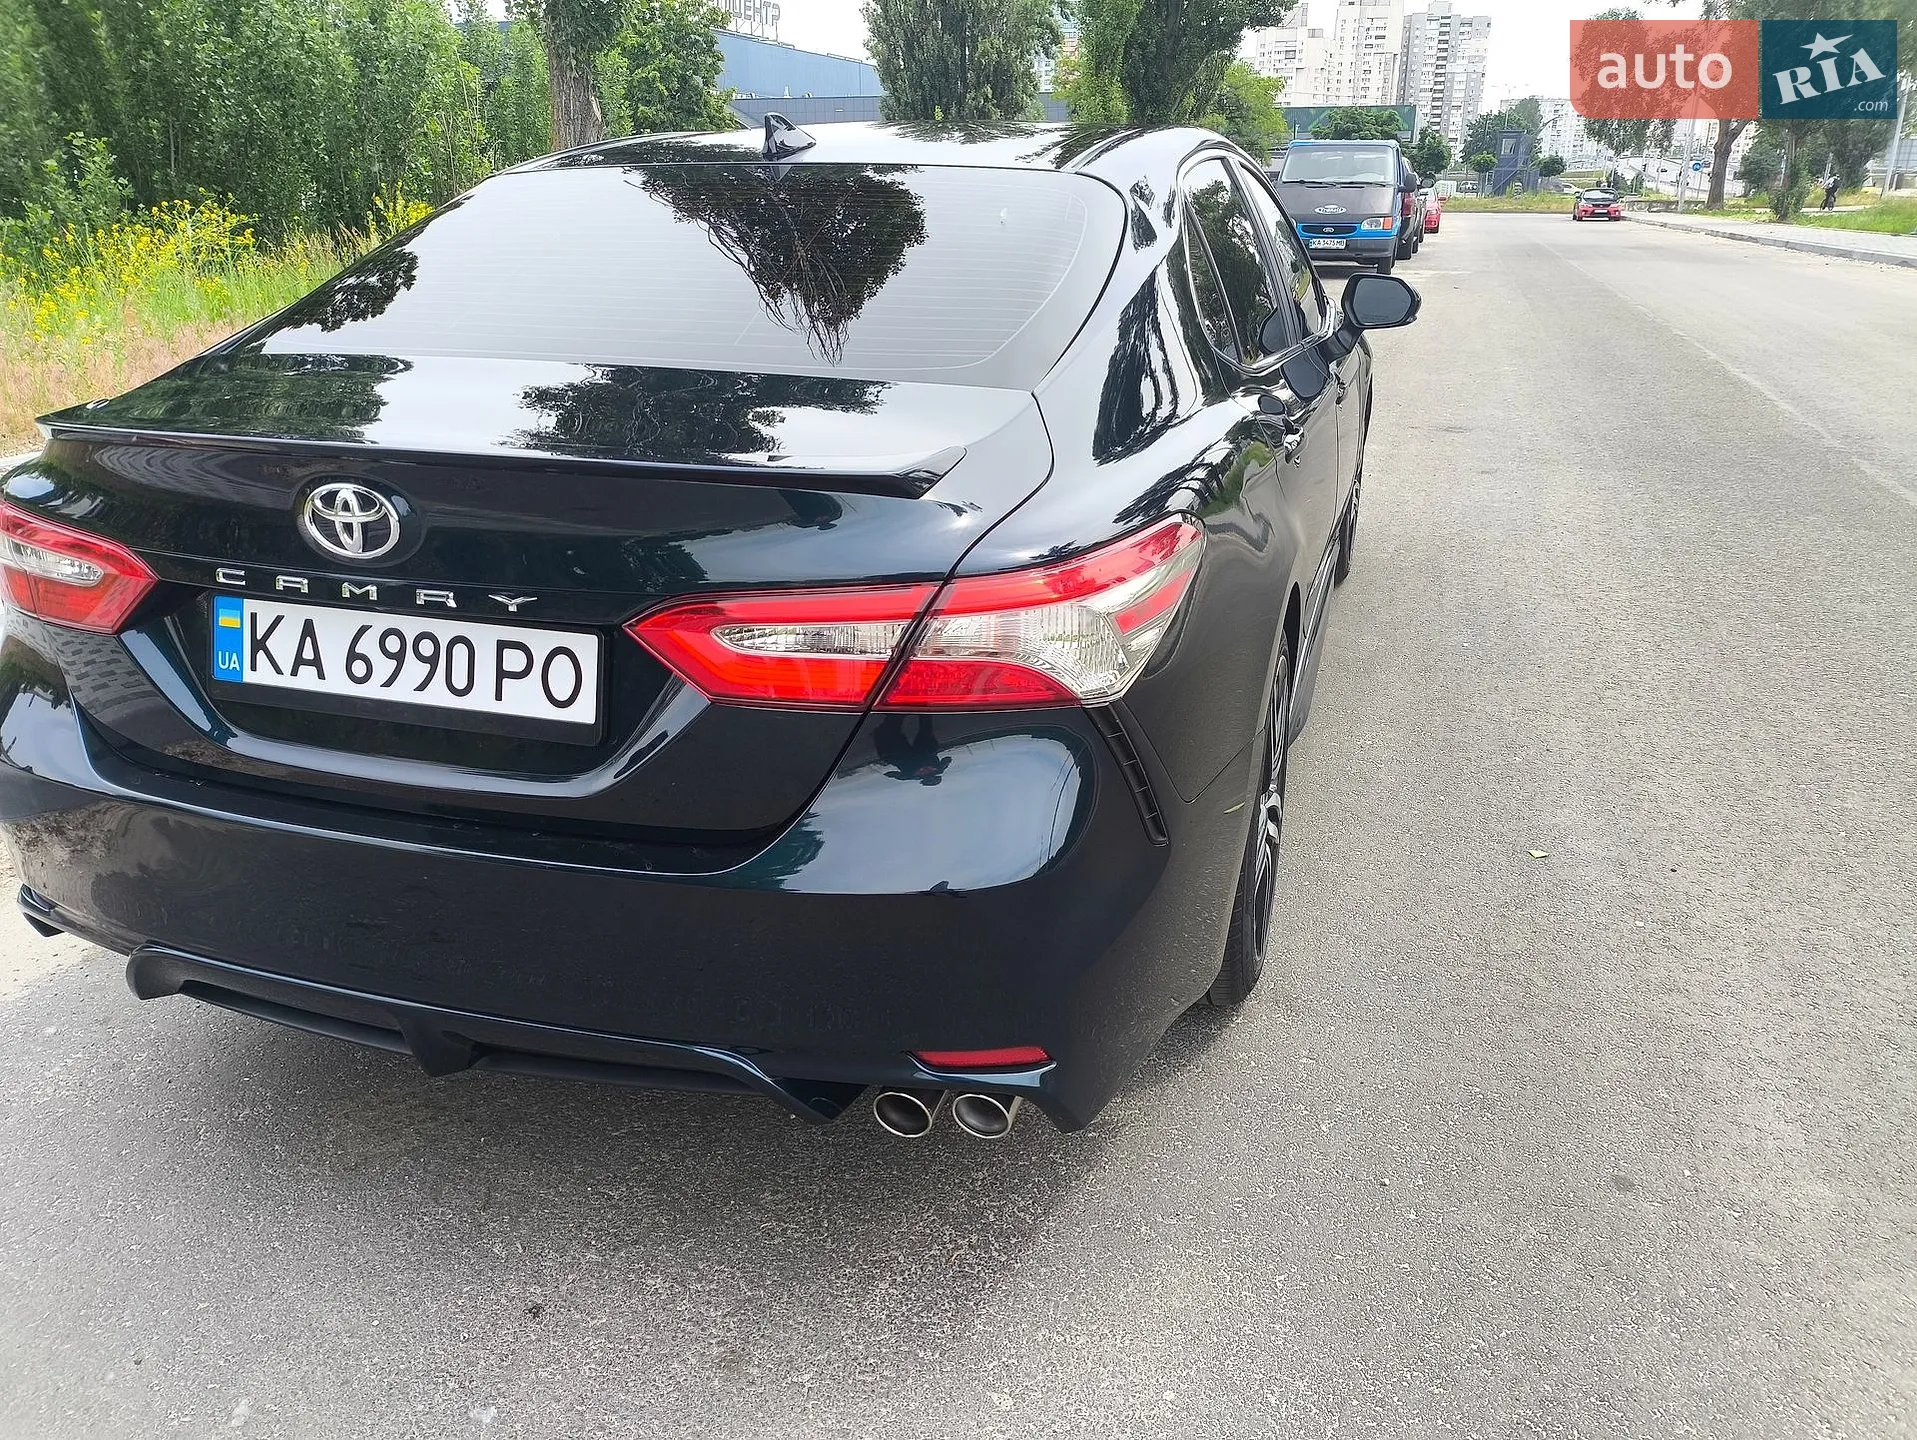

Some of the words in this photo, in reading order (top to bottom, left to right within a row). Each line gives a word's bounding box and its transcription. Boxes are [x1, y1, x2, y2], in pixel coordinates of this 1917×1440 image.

[214, 566, 538, 612] CAMRY
[218, 650, 240, 671] UA
[249, 611, 327, 681] KA
[345, 624, 476, 698] 6990
[494, 639, 583, 709] PO
